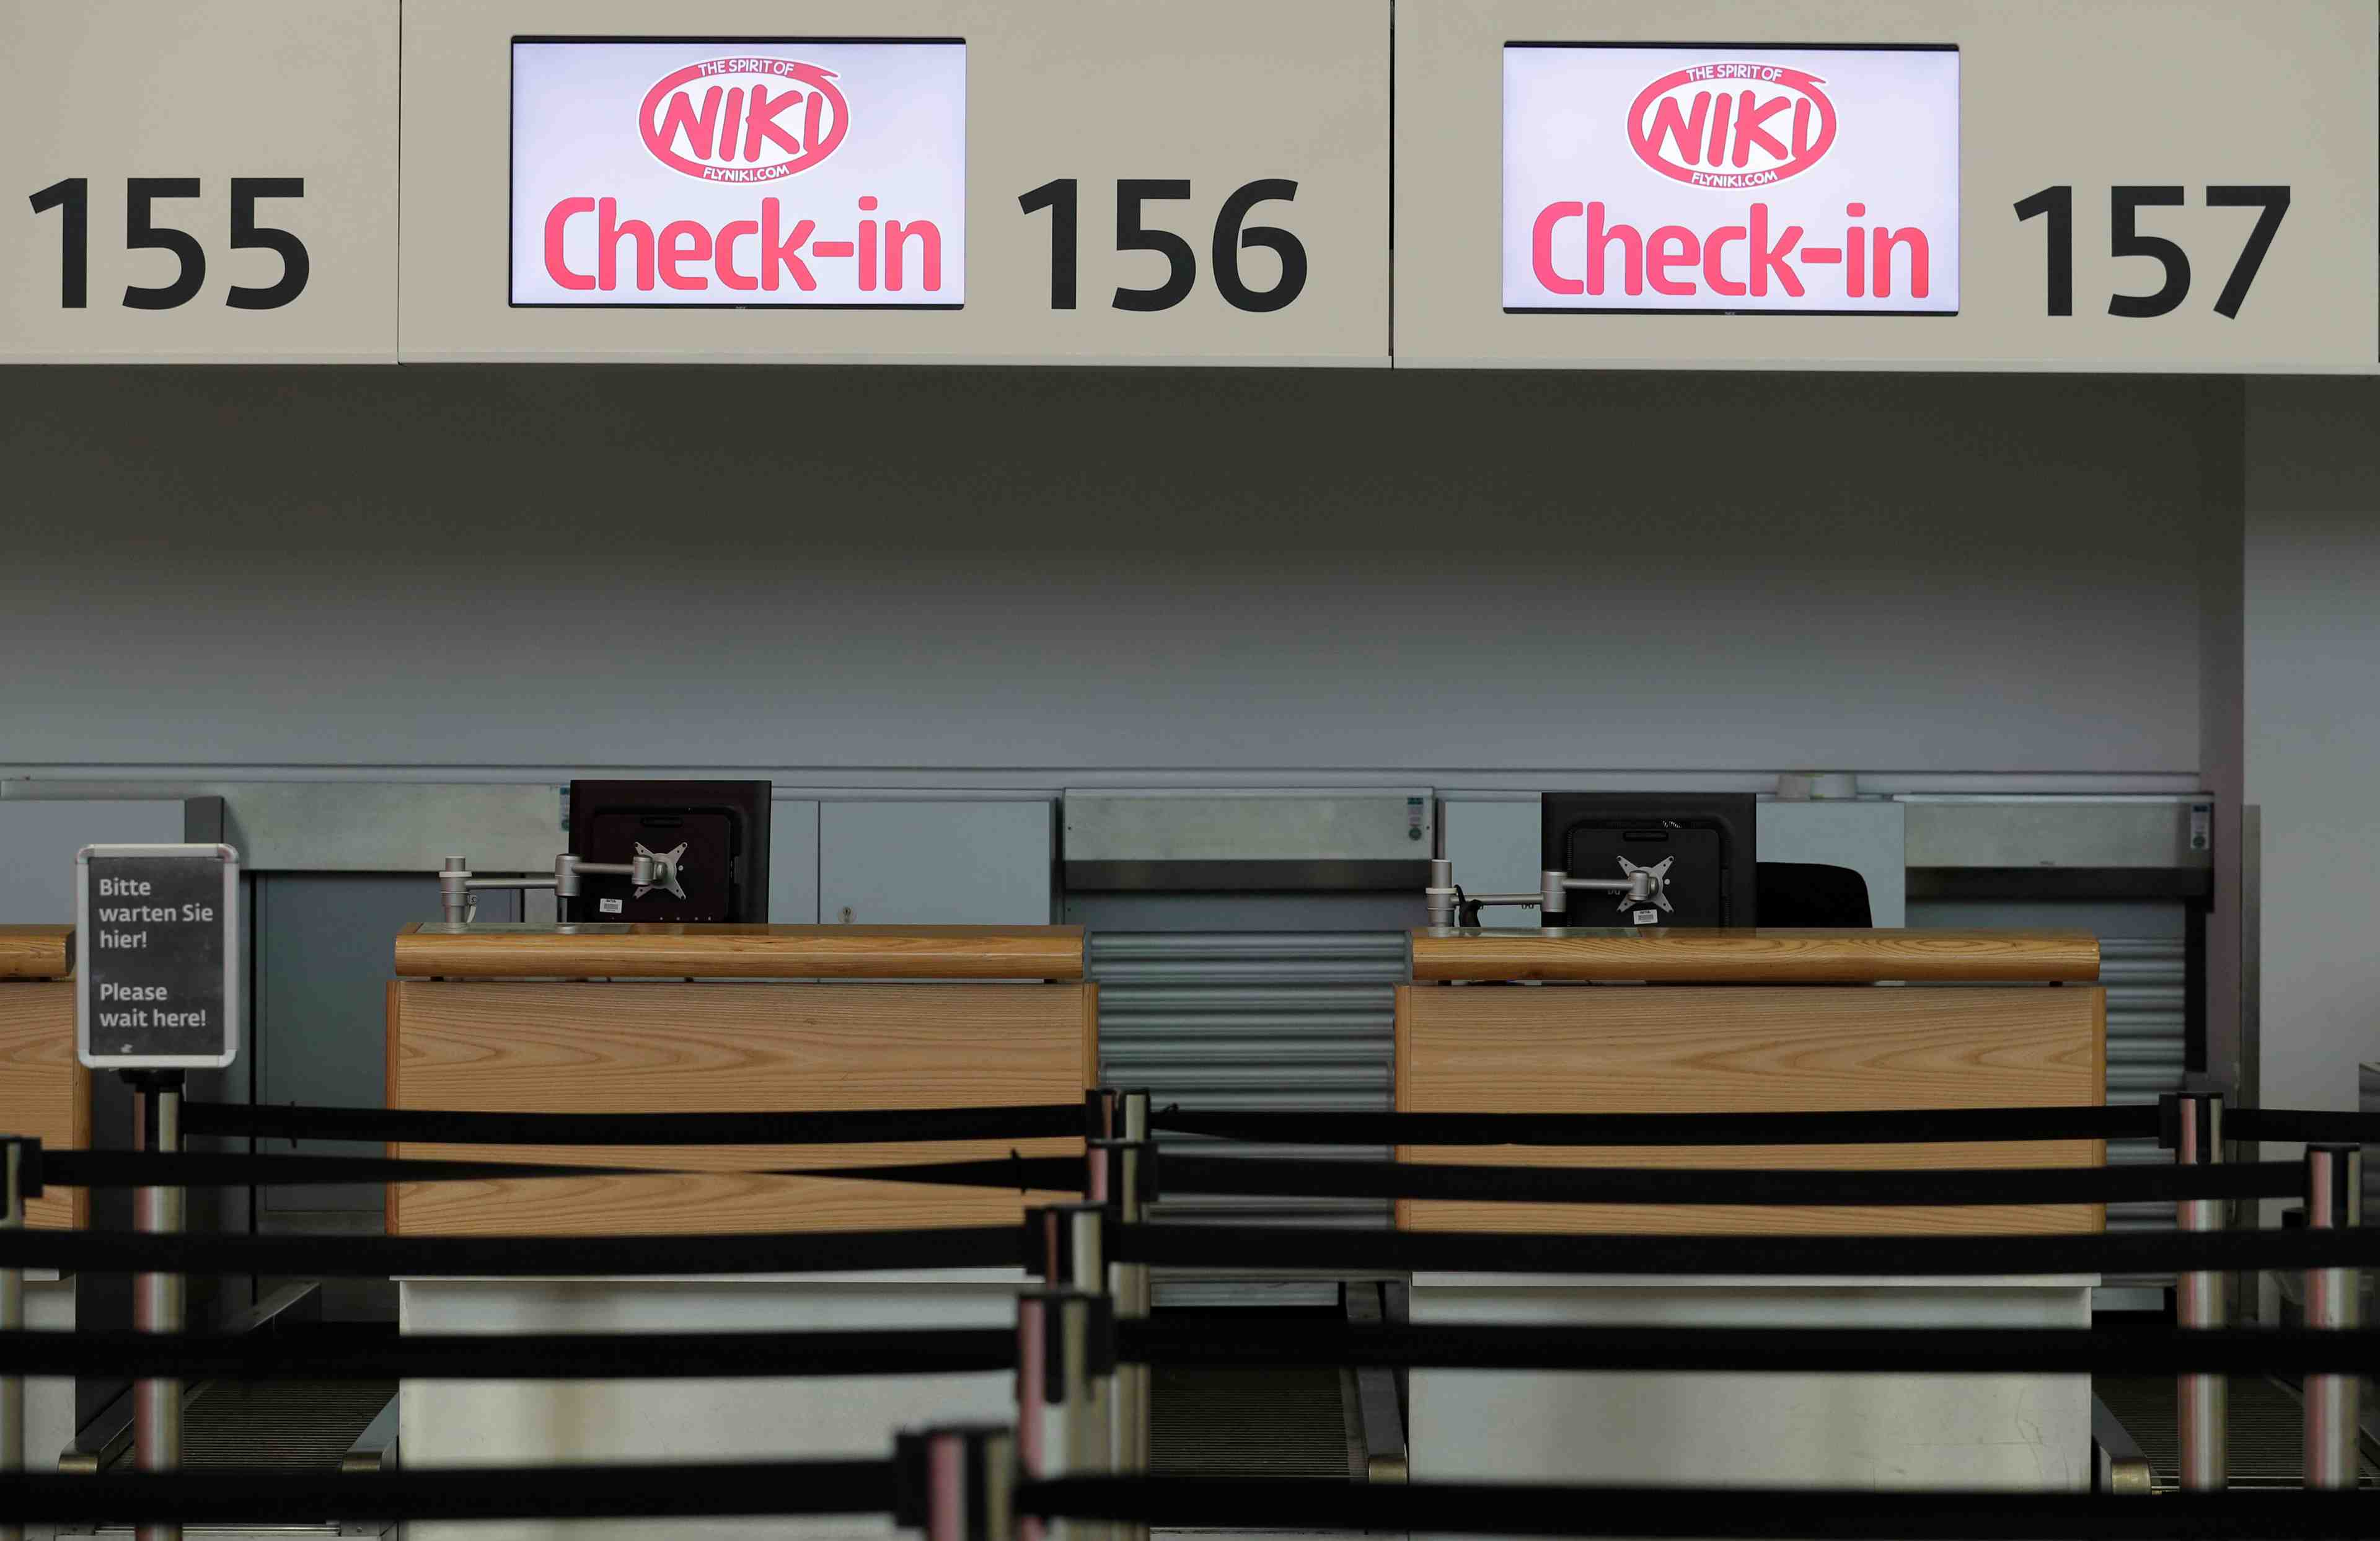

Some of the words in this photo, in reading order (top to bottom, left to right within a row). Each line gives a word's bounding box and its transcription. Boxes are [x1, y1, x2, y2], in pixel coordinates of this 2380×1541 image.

[698, 60, 726, 77] THE
[728, 59, 772, 73] SPIRIT
[773, 61, 795, 76] OF
[1686, 66, 1714, 82] THE
[1717, 64, 1761, 79] SPIRIT
[1761, 67, 1783, 82] OF
[654, 84, 823, 162] NIKI
[1644, 90, 1811, 168] NIKI
[703, 164, 790, 182] FLYNIKI.COM
[1691, 170, 1778, 187] FLYNIKI.COM
[29, 178, 309, 309] 155
[545, 196, 941, 291] Check-in
[1018, 179, 1307, 312] 156
[1533, 201, 1929, 298] Check-in
[2013, 186, 2290, 319] 157
[99, 878, 151, 896] Bitte
[99, 906, 177, 922] warten
[182, 903, 214, 922] Sie
[100, 930, 148, 948] hier!
[100, 982, 168, 1001] Please
[99, 1009, 148, 1027] wait
[153, 1009, 206, 1027] here!
